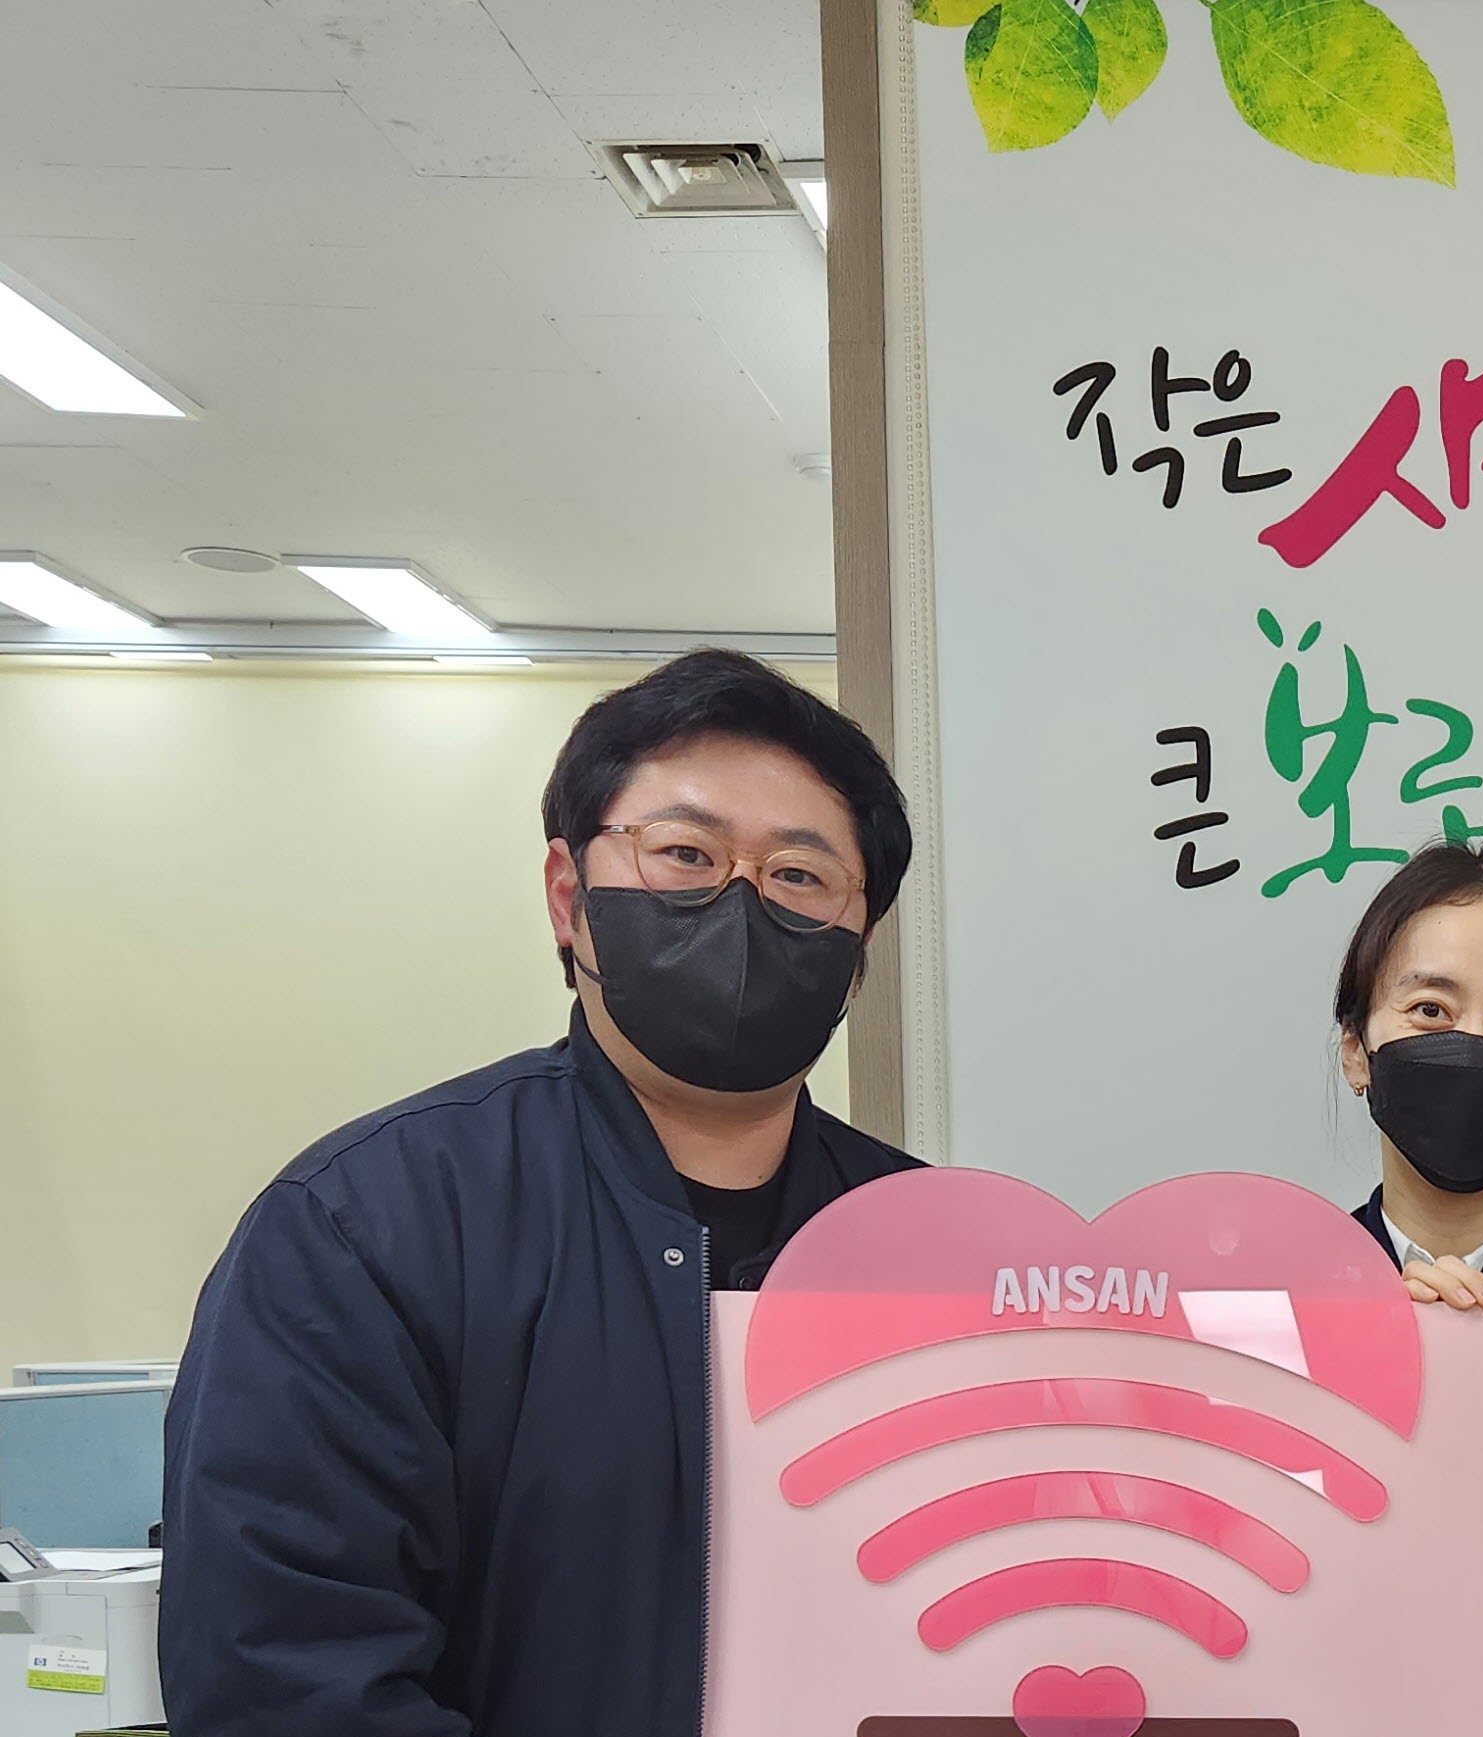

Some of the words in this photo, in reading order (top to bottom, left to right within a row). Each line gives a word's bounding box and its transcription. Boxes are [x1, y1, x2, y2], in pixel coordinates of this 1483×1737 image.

[1053, 347, 1292, 508] 작은
[1151, 726, 1241, 889] 큰
[991, 1264, 1170, 1319] ANSAN
